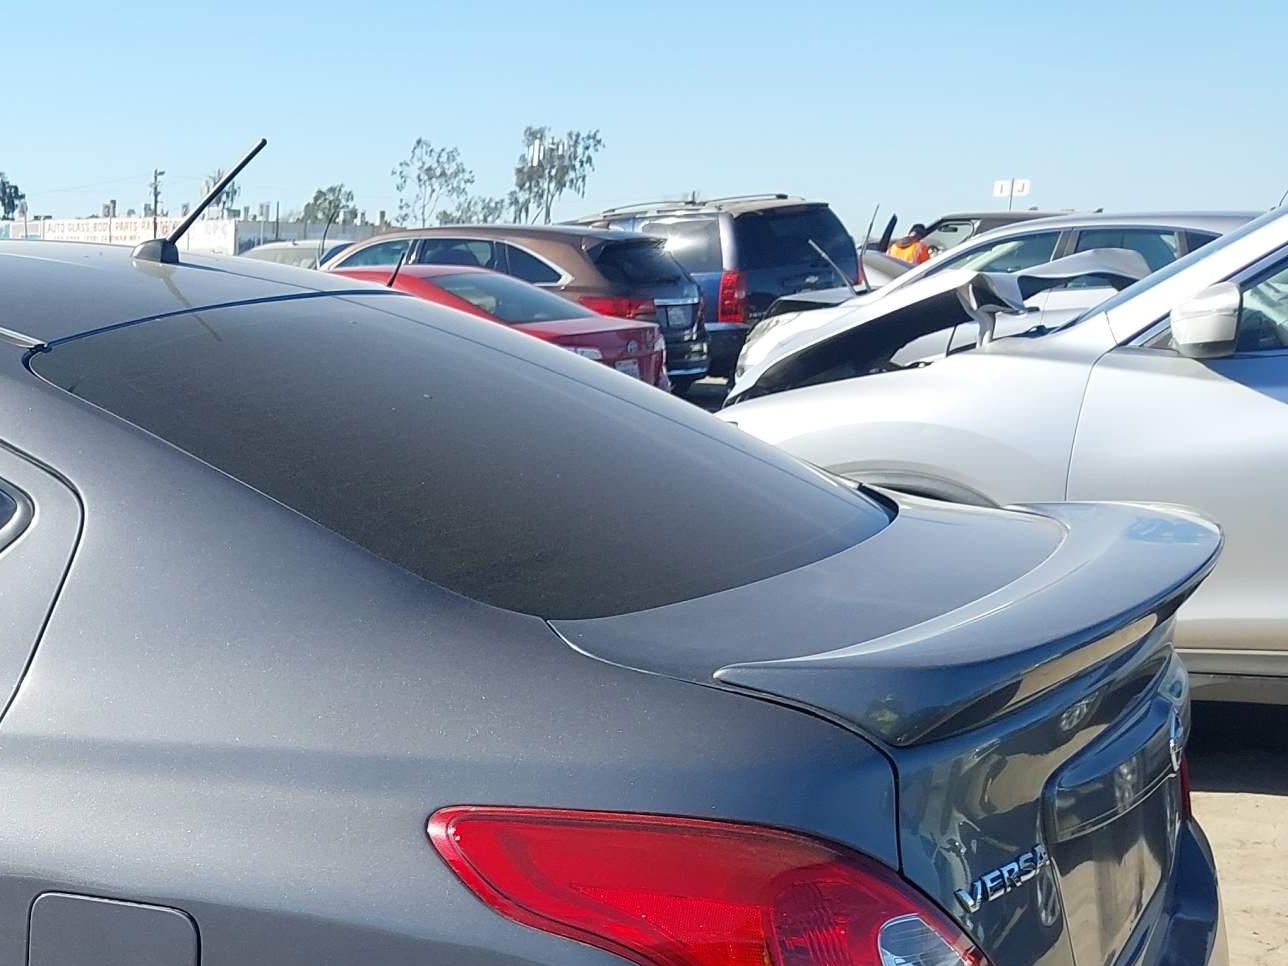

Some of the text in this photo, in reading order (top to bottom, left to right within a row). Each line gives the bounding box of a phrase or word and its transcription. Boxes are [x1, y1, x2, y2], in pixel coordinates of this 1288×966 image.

[1017, 183, 1025, 193] J
[47, 222, 65, 233] AUTO
[68, 222, 90, 233] GLASS
[954, 843, 1052, 914] VERSA
